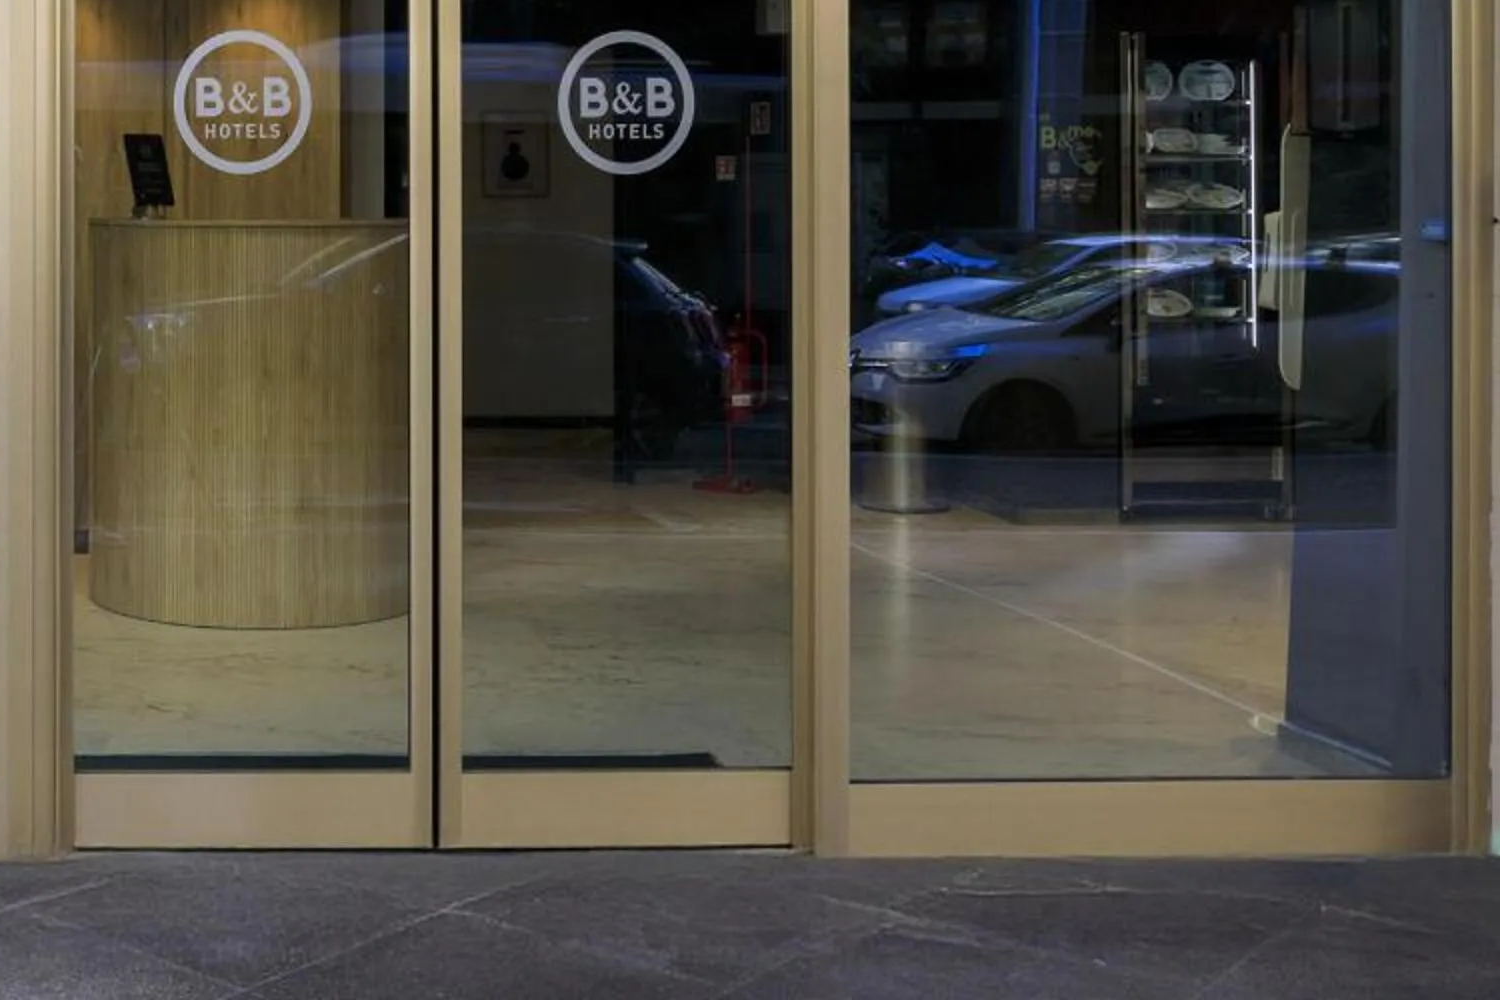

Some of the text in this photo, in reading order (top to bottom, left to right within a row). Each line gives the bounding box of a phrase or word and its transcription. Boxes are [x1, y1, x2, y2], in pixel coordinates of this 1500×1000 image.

[195, 76, 292, 118] B&B
[579, 77, 675, 118] B&B
[205, 123, 281, 139] HOTELS
[588, 123, 664, 140] HOTELS
